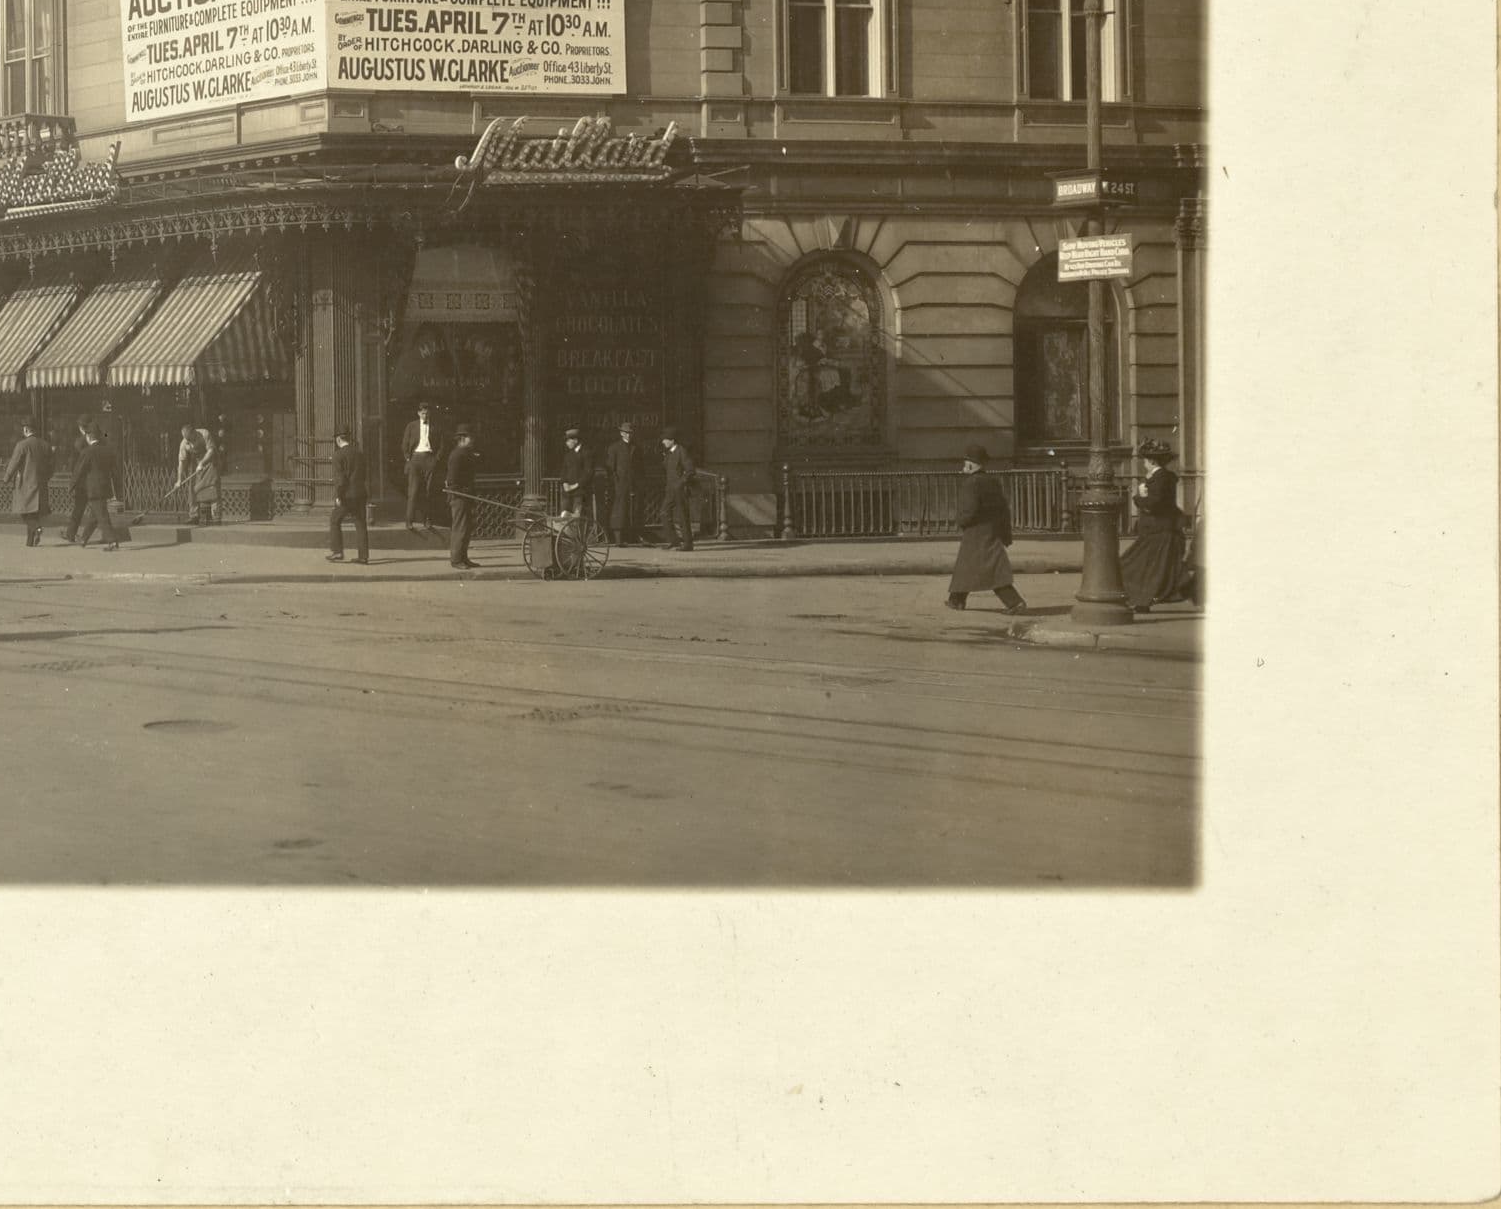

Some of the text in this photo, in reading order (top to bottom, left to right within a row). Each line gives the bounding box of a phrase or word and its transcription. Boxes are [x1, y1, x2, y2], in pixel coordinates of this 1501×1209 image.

[149, 13, 189, 37] FURNITURE
[194, 3, 238, 27] COMPLETE
[528, 20, 544, 36] AT
[583, 21, 611, 37] A.M.
[251, 26, 264, 45] AT
[291, 15, 315, 37] A.M.
[254, 49, 262, 63] &
[263, 46, 281, 61] CO.
[527, 40, 538, 54] &
[541, 40, 563, 55] CO.
[338, 56, 425, 81] AUGUSTUS
[543, 61, 567, 73] Office
[567, 61, 579, 73] 43
[580, 62, 603, 76] Liberty
[132, 83, 190, 113] AUGUSTUS
[1058, 181, 1096, 196] BROADWAY
[556, 349, 653, 368] BREAKFAST
